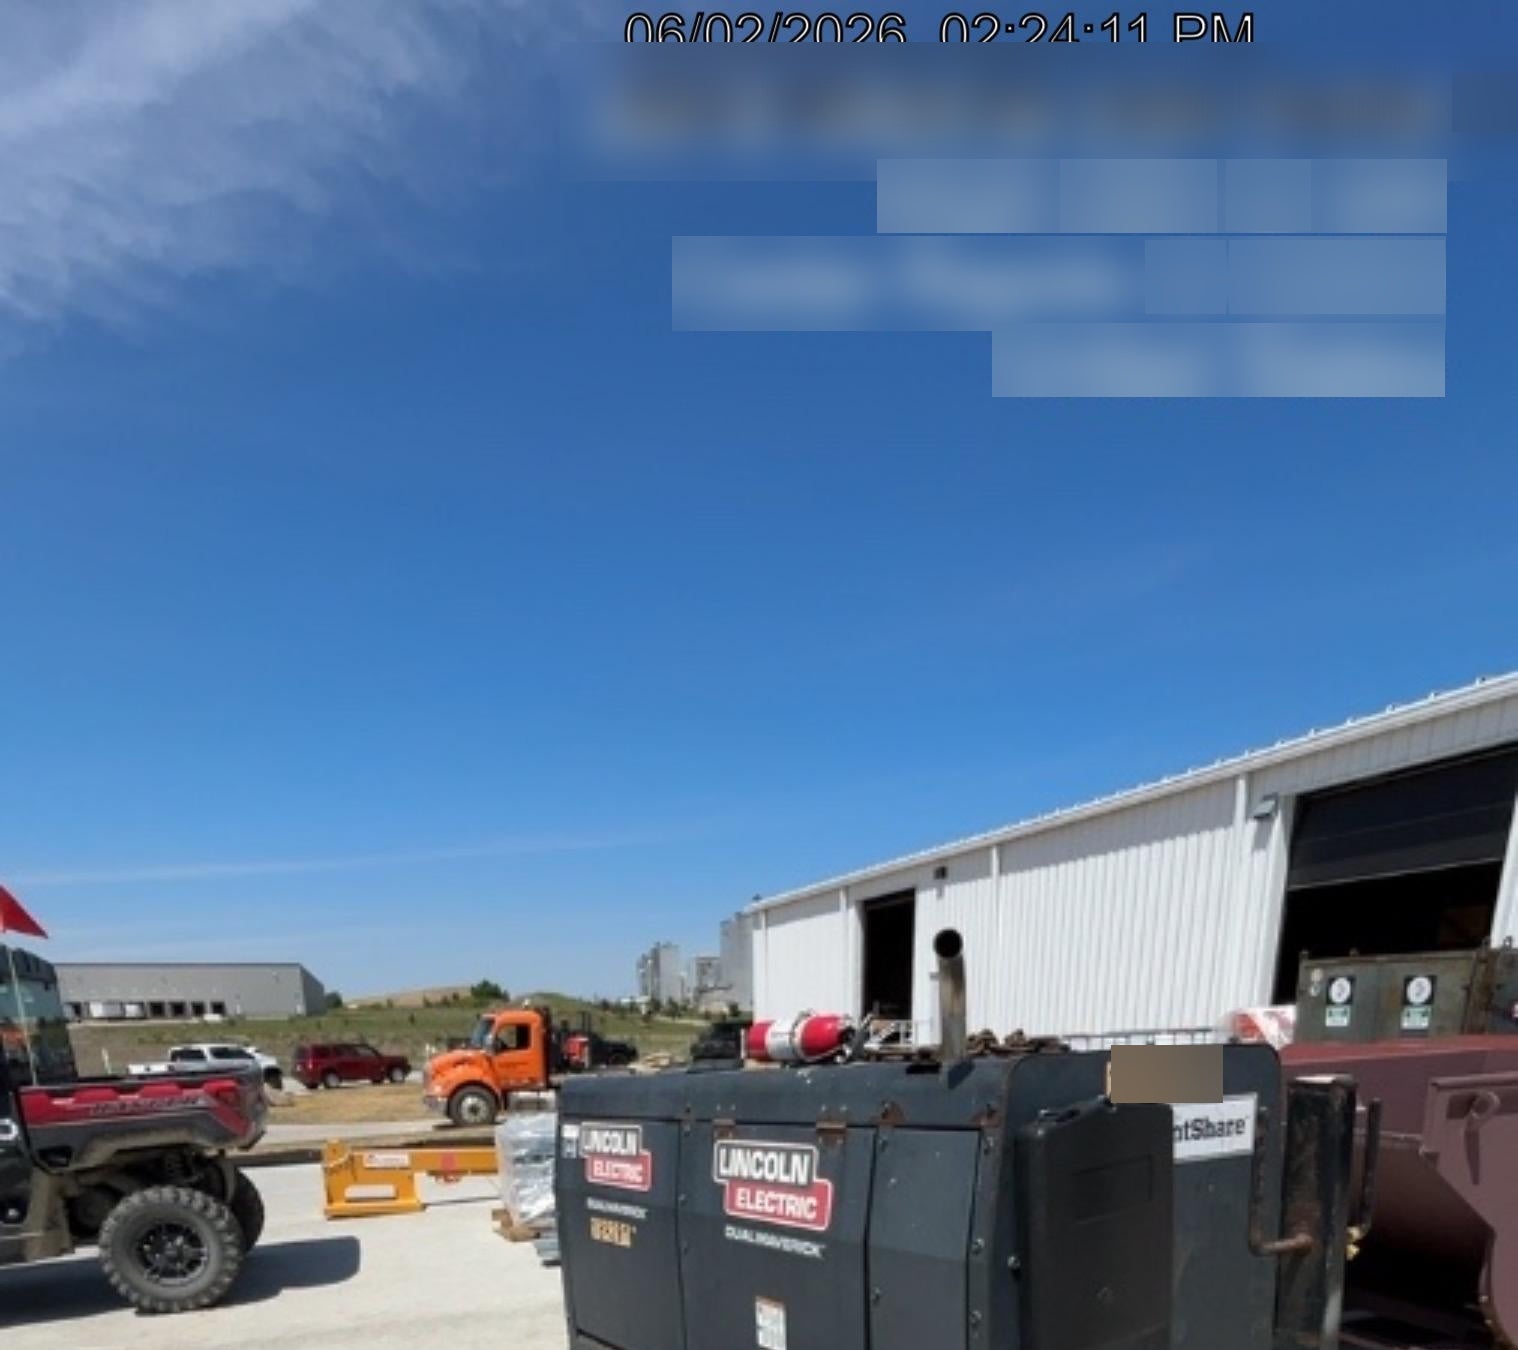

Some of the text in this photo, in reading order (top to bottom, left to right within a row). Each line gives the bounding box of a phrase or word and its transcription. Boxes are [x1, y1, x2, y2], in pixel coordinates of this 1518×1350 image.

[1172, 1116, 1246, 1143] ntShare
[593, 1159, 643, 1183] ELECTRIC
[719, 1147, 811, 1186] LINCOLN
[734, 1187, 817, 1221] ELECTRIC
